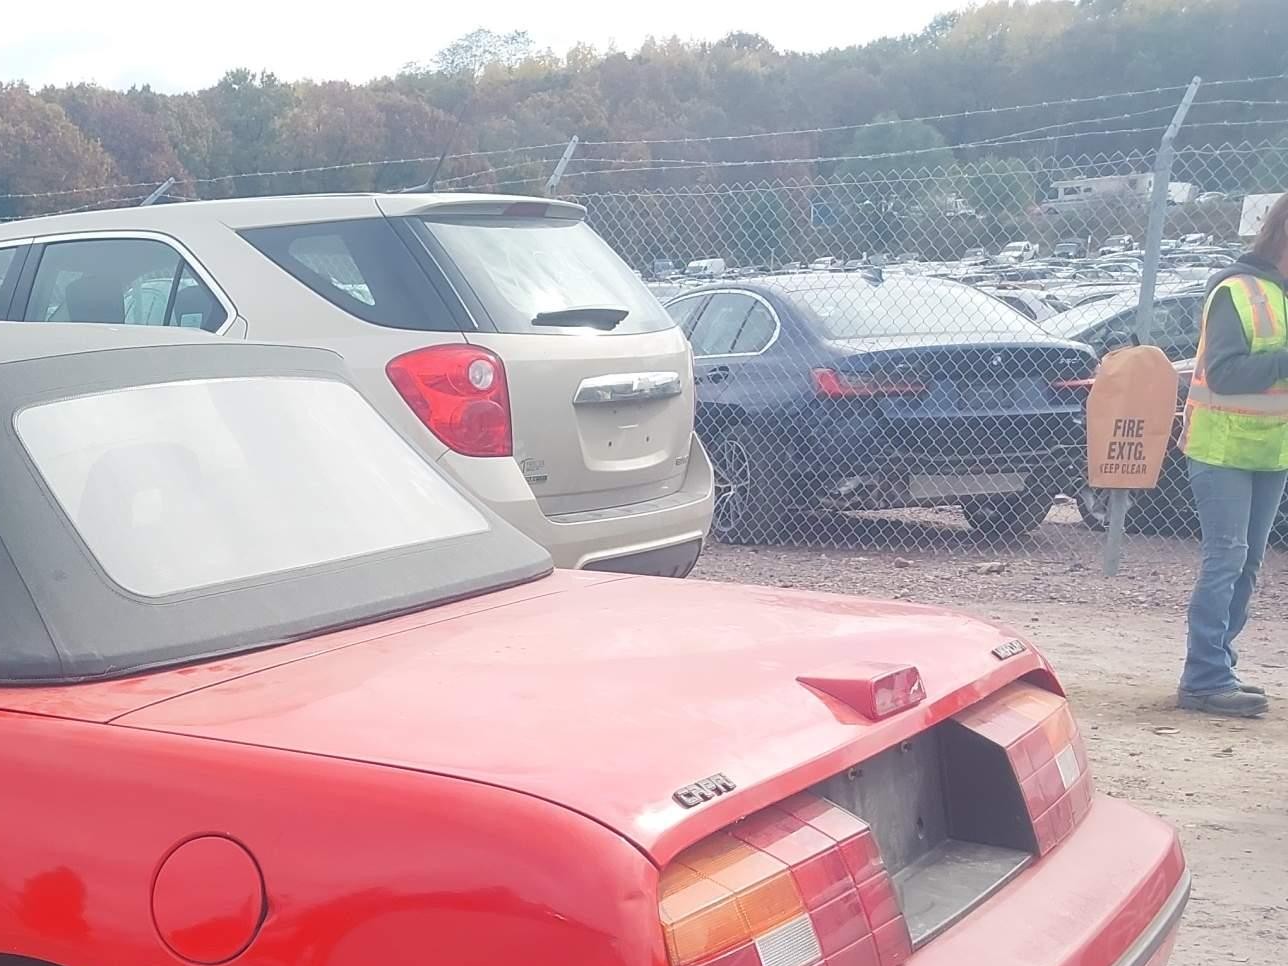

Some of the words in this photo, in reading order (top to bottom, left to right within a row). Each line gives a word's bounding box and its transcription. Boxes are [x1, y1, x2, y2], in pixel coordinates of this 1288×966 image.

[1113, 419, 1144, 437] FIRE
[1107, 441, 1146, 460] EXTG.
[1121, 463, 1147, 475] CLEAR
